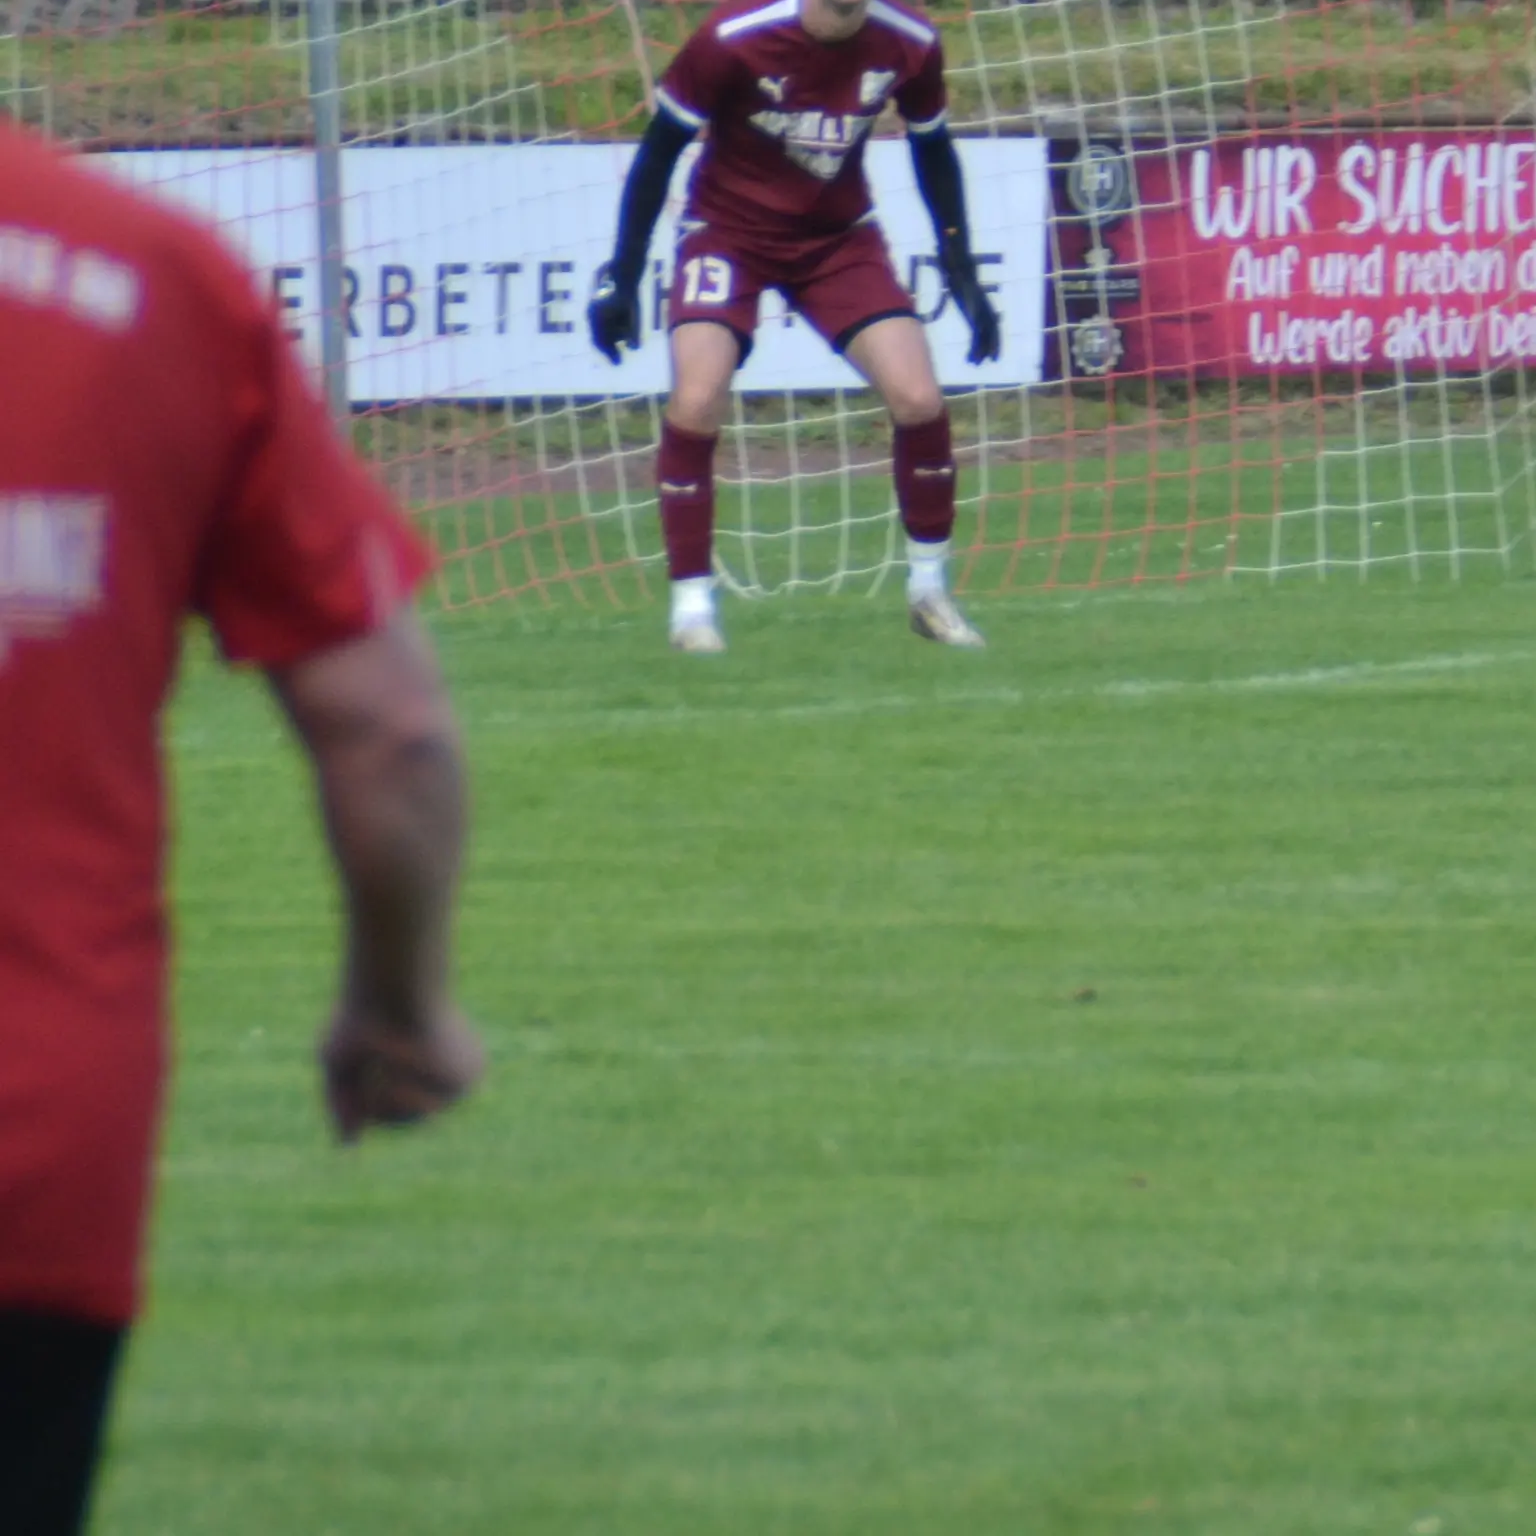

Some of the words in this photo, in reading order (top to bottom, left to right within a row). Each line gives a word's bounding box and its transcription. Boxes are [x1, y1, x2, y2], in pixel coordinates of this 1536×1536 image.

[1190, 144, 1316, 239] WIR
[683, 255, 732, 305] 13
[1226, 244, 1300, 301] Auf
[1309, 243, 1385, 298] und
[1394, 240, 1507, 295] neben
[1249, 309, 1374, 364] Werde
[1382, 306, 1483, 360] aktiv
